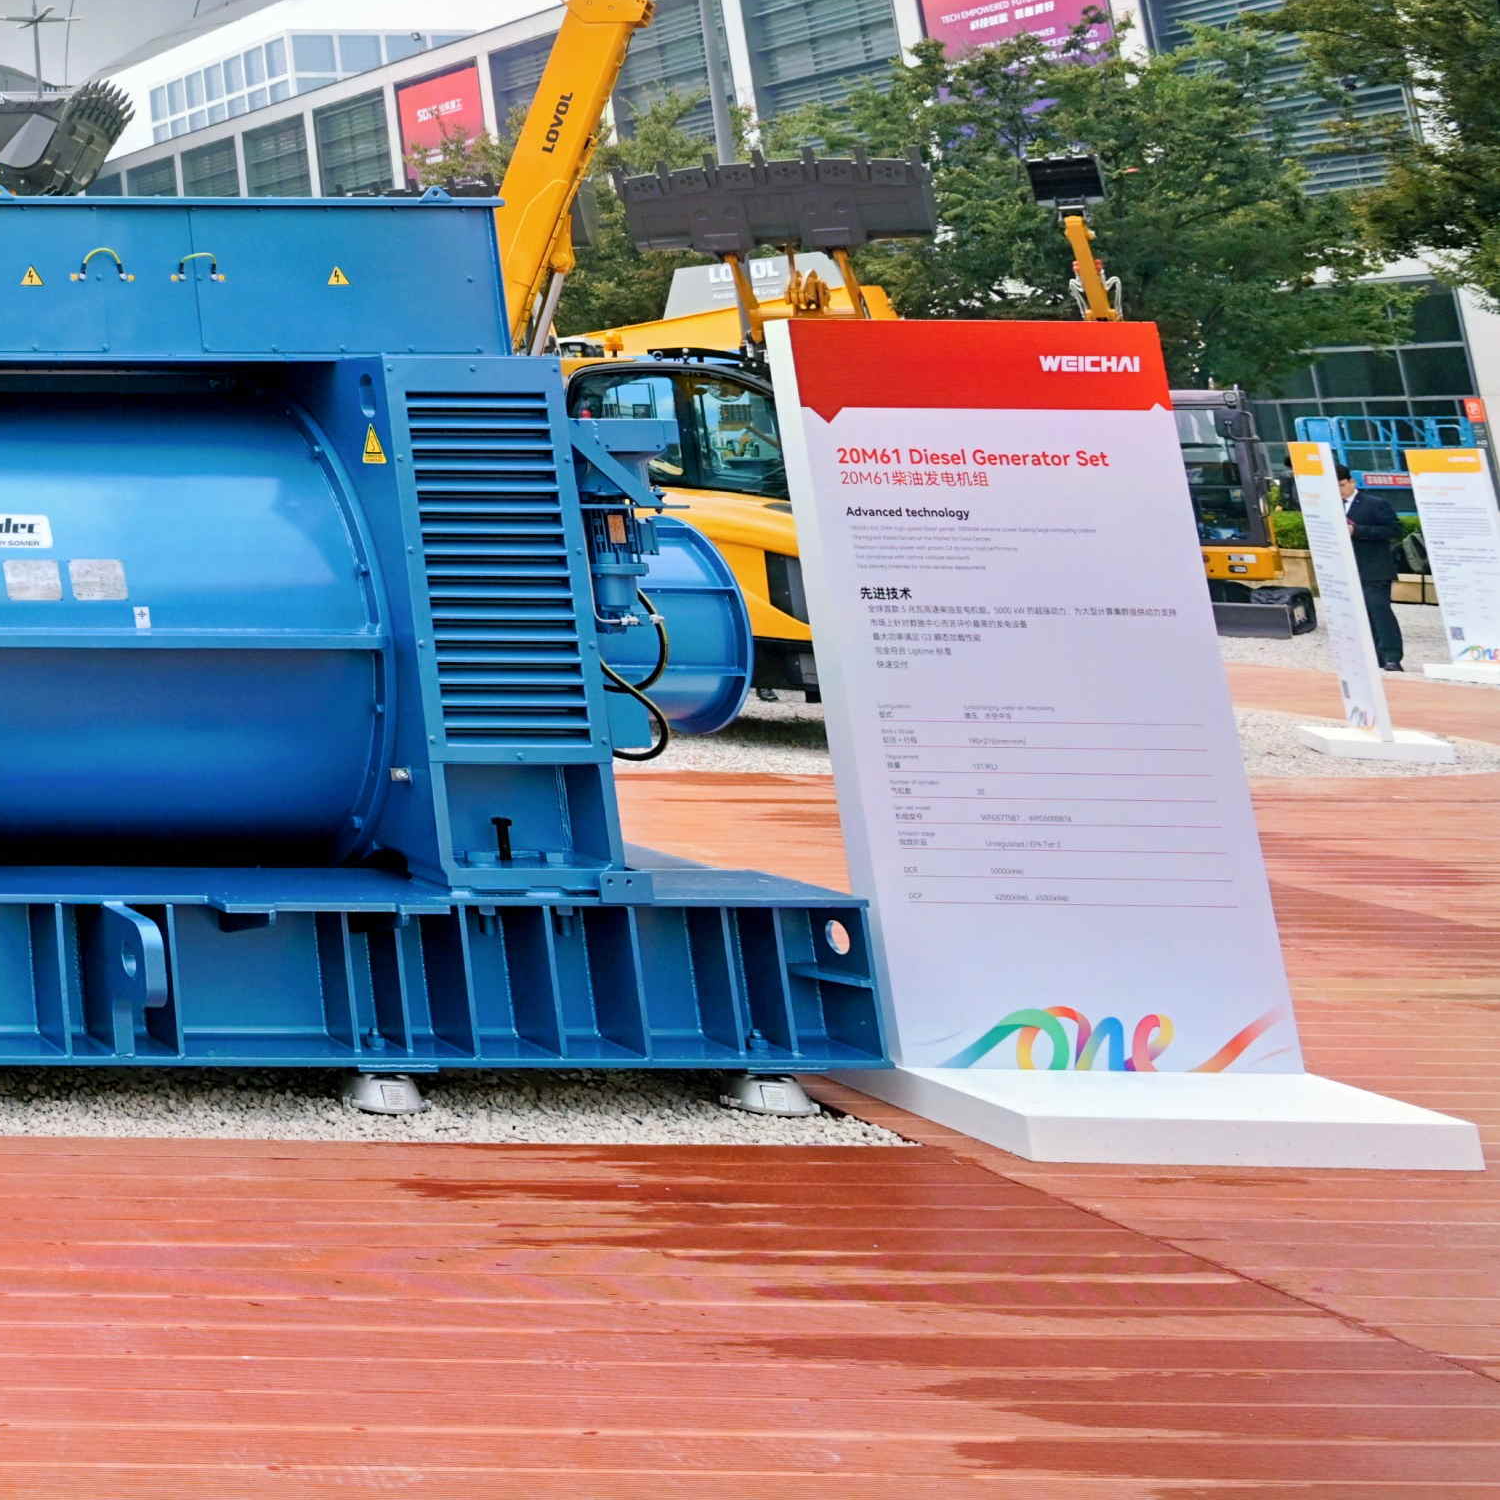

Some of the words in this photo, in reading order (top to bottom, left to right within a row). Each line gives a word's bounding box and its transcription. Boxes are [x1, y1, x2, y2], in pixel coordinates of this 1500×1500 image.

[541, 92, 574, 154] LOVOL
[1039, 355, 1140, 372] WEICHAI
[837, 448, 902, 465] 20M61
[908, 448, 966, 466] Diesel
[972, 449, 1071, 467] Generator
[1075, 450, 1110, 467] Set
[841, 471, 989, 487] 20M61柴油发电机组
[846, 506, 903, 518] Advanced
[905, 507, 970, 520] technology
[860, 587, 912, 600] 先进技术
